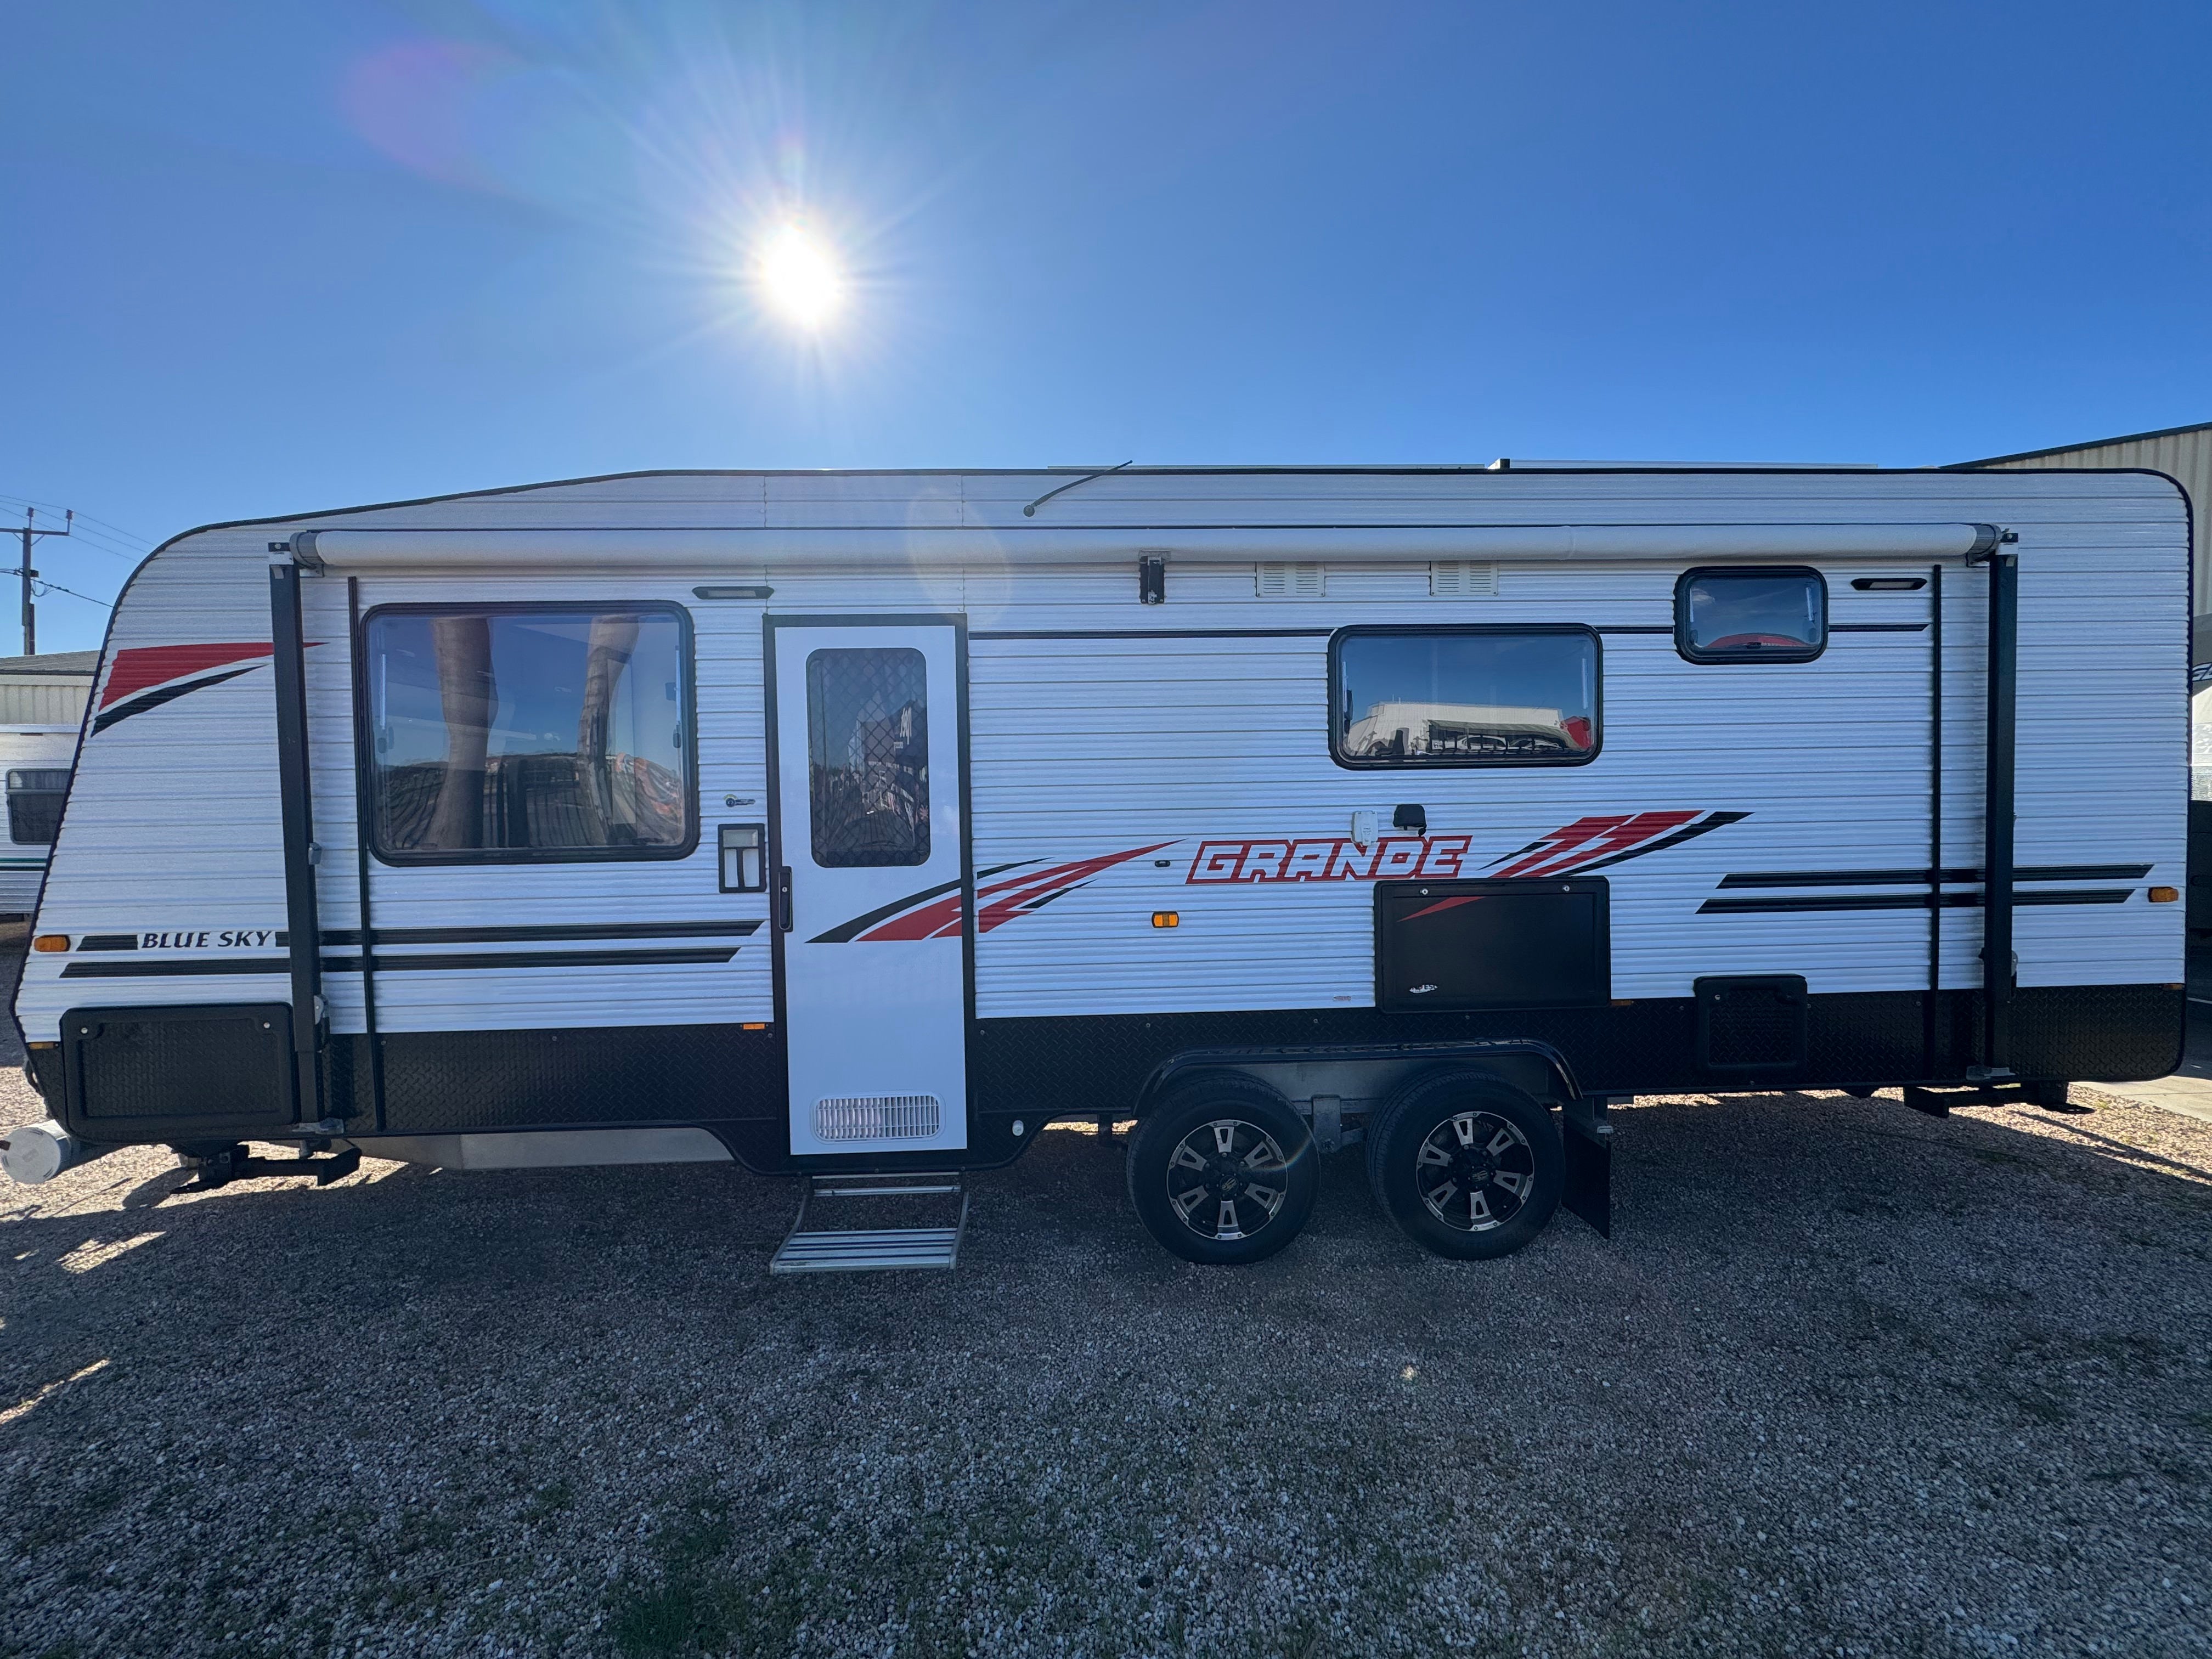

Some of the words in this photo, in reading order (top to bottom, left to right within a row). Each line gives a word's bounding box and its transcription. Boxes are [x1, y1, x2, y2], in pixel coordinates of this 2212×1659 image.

[1186, 835, 1473, 884] GRANDE
[141, 932, 211, 949] BLUE
[217, 930, 272, 947] SKY
